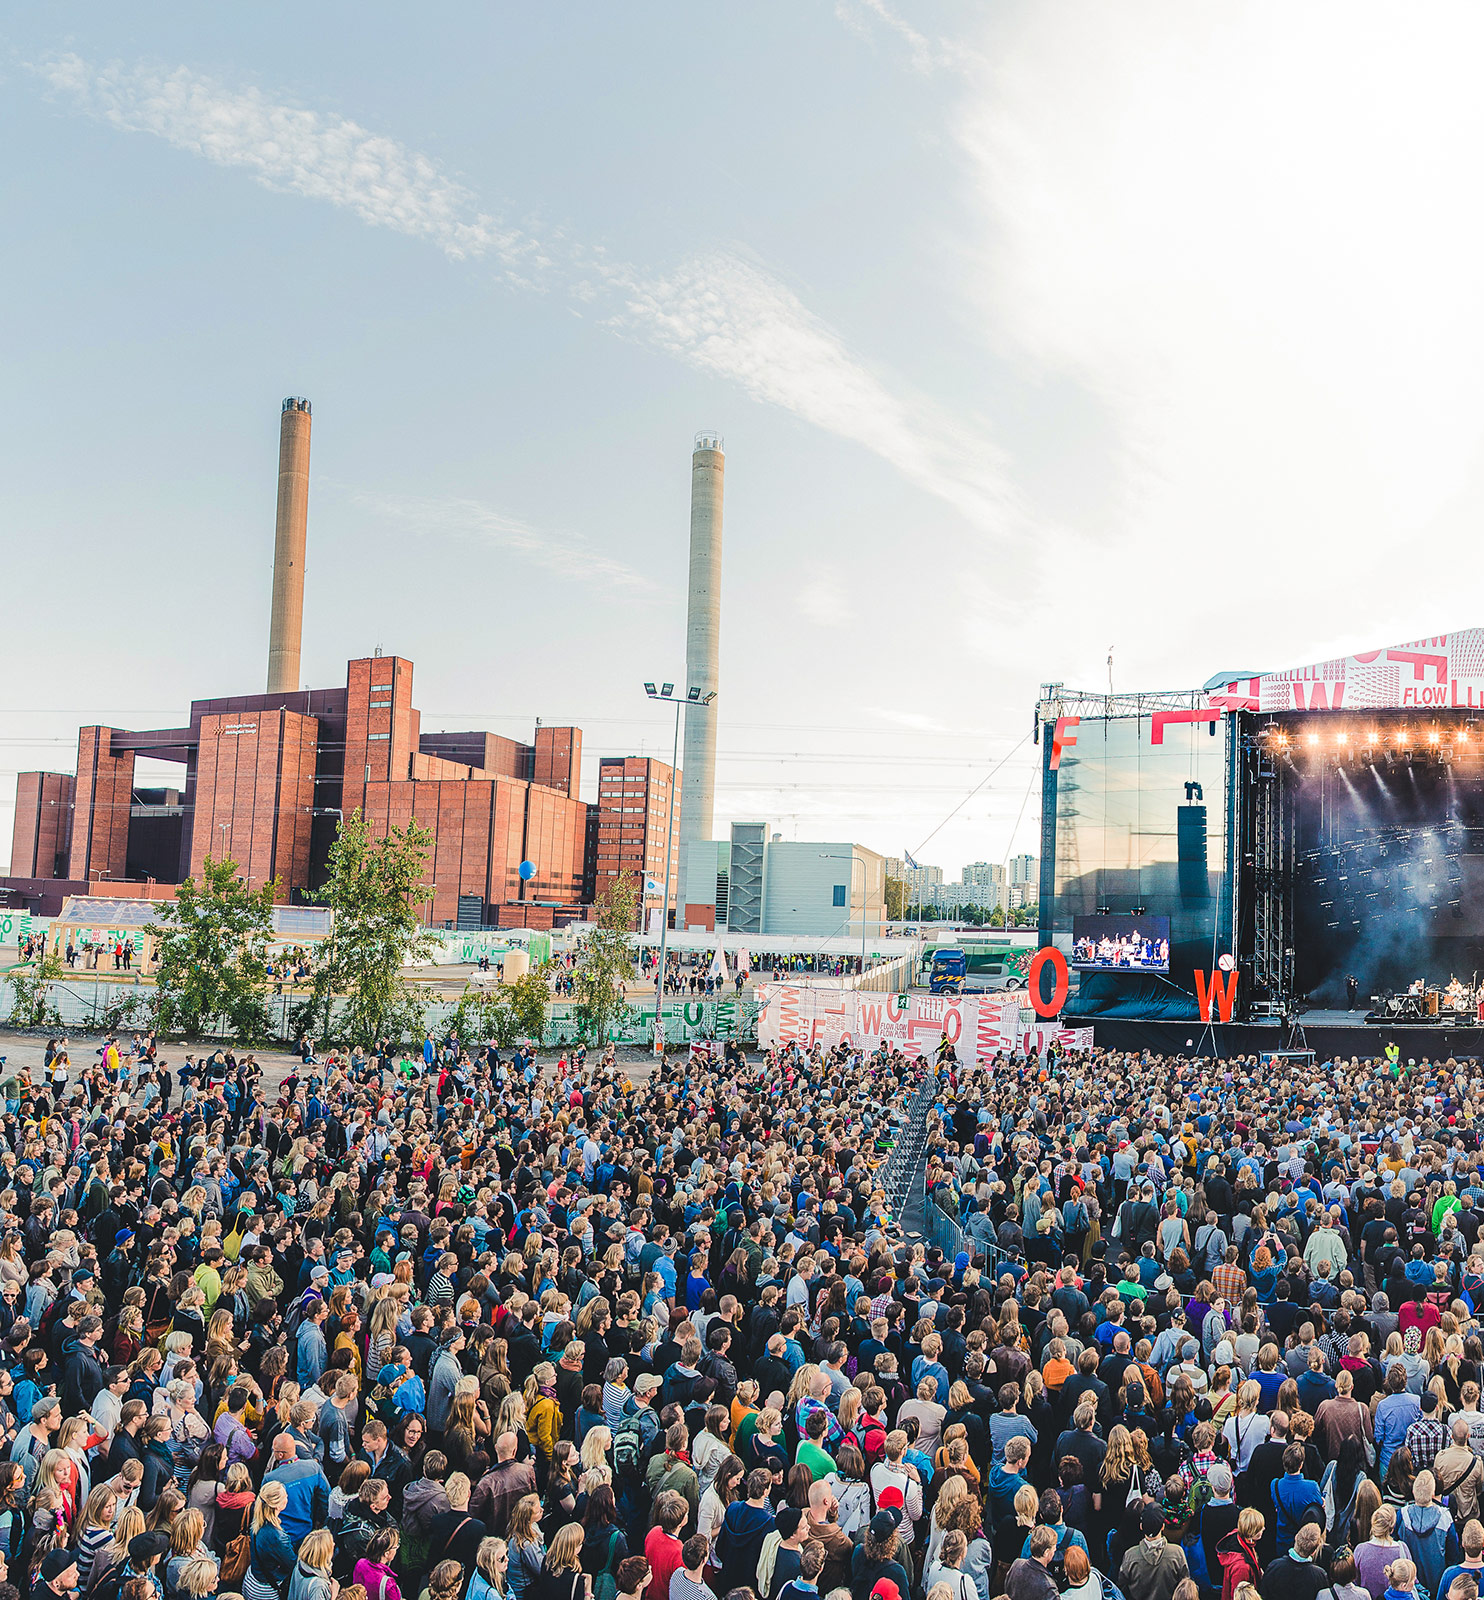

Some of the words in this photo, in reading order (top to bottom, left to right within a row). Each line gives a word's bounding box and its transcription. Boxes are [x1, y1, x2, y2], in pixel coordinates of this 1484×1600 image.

[1293, 682, 1346, 710] W
[1403, 687, 1448, 705] FLOW
[1049, 716, 1080, 770] F
[1151, 708, 1220, 745] L
[1194, 969, 1240, 1022] W
[797, 1017, 810, 1050] FLOW
[861, 1004, 883, 1035] W
